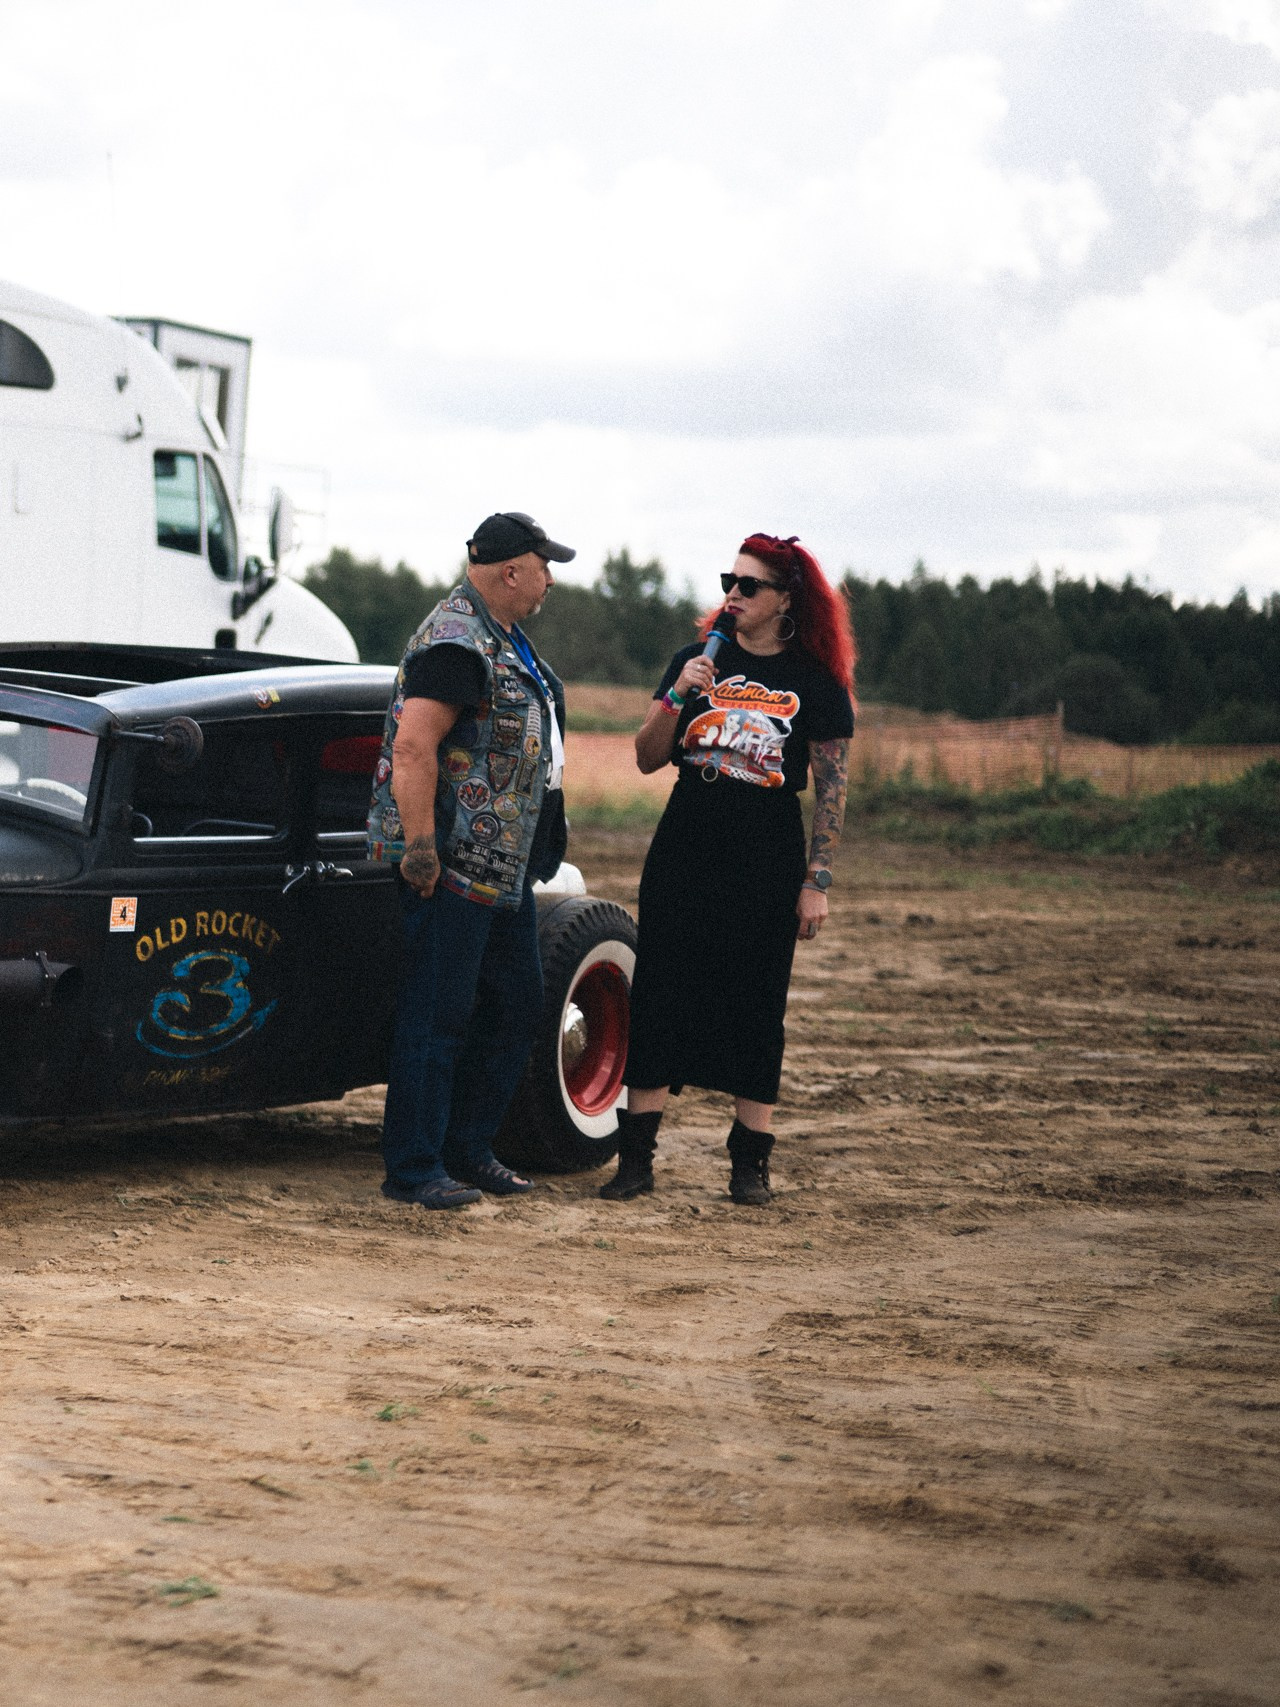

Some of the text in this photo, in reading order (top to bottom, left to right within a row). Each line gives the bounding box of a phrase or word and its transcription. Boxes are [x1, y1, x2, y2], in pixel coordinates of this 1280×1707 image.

[120, 906, 127, 921] 4
[136, 910, 281, 962] OLD ROCKET
[151, 947, 252, 1041] 3
